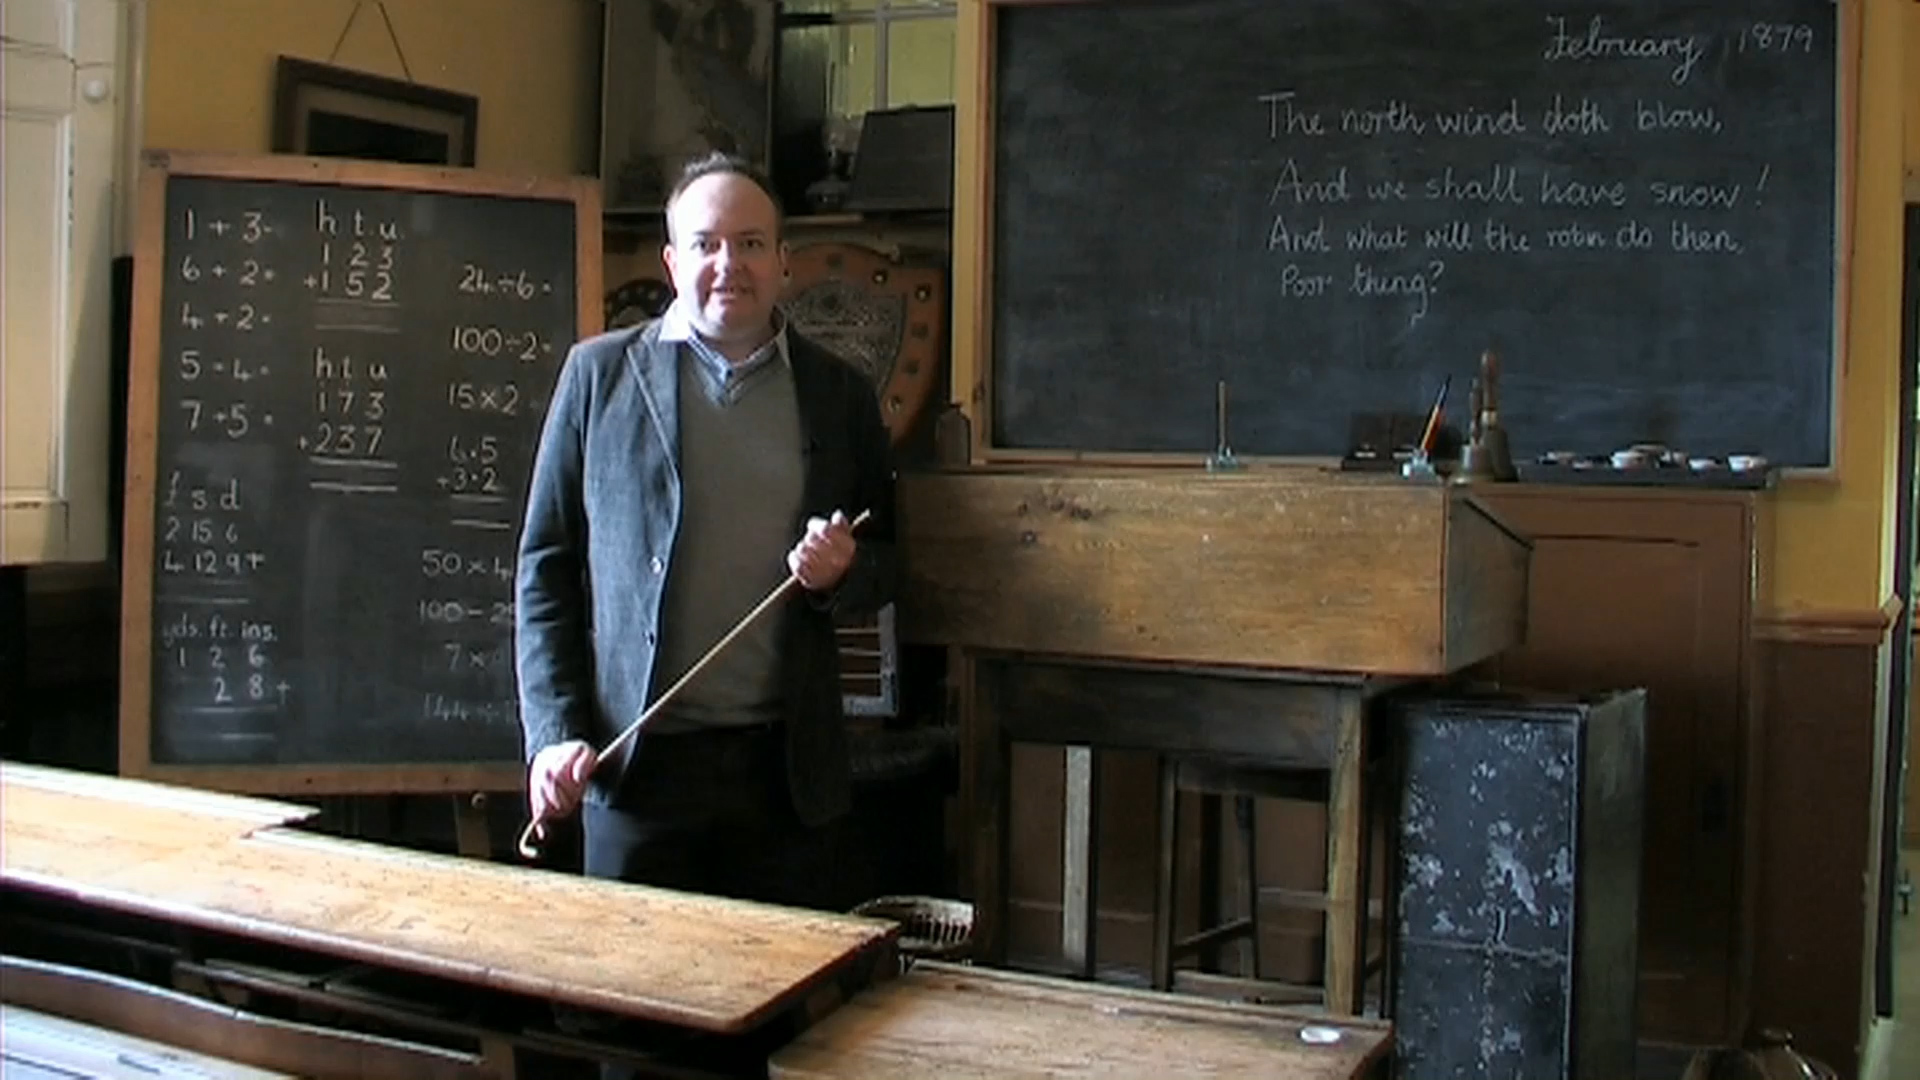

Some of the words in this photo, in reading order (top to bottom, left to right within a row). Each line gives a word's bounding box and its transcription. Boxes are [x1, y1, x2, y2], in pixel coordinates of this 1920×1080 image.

[1544, 15, 1705, 86] February
[1737, 21, 1814, 54] 1879
[1257, 91, 1325, 139] The
[1341, 99, 1427, 136] north
[1435, 98, 1528, 137] wind
[1542, 93, 1609, 135] doth
[1636, 99, 1723, 134] blow,
[1268, 157, 1351, 206] And
[1366, 180, 1408, 200] we
[1425, 163, 1525, 204] shall
[1540, 170, 1628, 207] have
[1268, 215, 1331, 252] And
[1347, 220, 1410, 250] what
[1425, 219, 1474, 250] will
[1483, 217, 1532, 252] the
[1615, 219, 1654, 249] do
[1280, 262, 1333, 298] Poor
[1349, 260, 1446, 328] thing?
